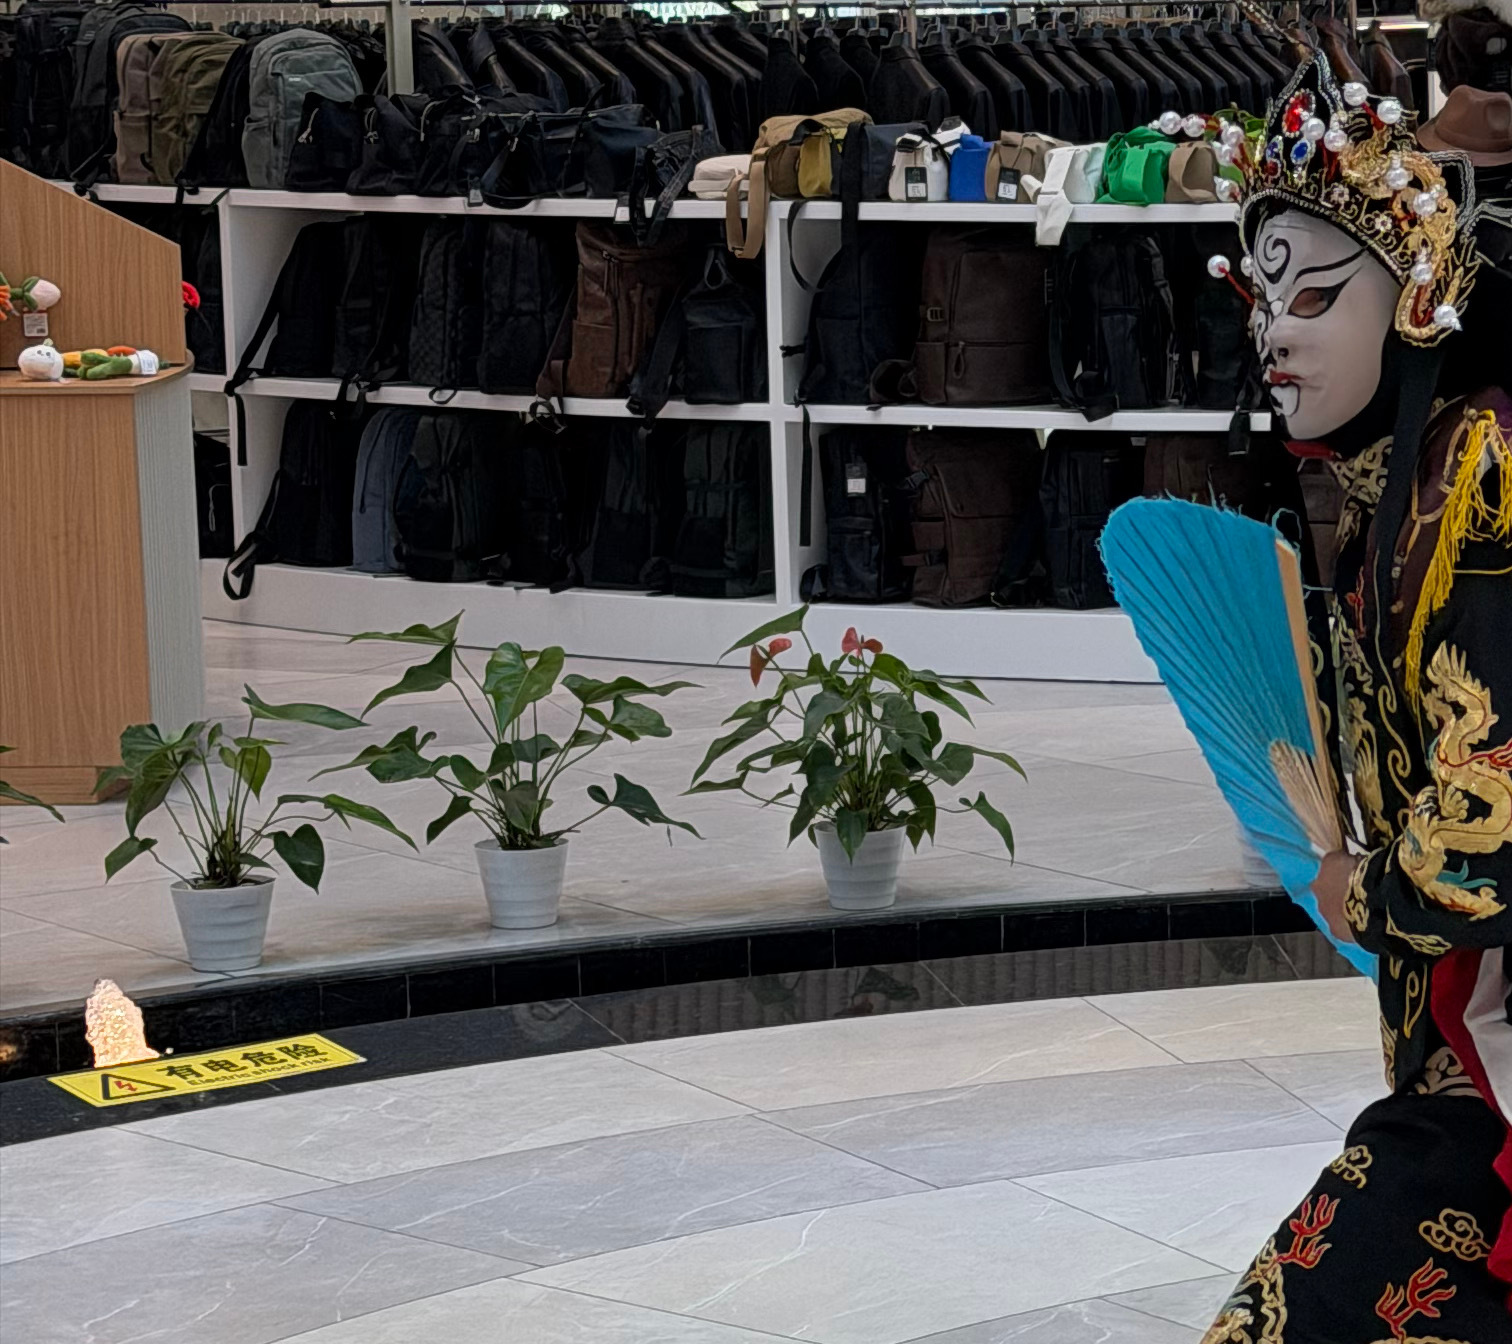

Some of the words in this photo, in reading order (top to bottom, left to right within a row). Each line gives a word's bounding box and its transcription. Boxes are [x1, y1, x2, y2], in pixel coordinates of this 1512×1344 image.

[156, 1043, 328, 1079] 有电危险
[186, 1072, 251, 1086] Electric
[300, 1056, 331, 1068] risk
